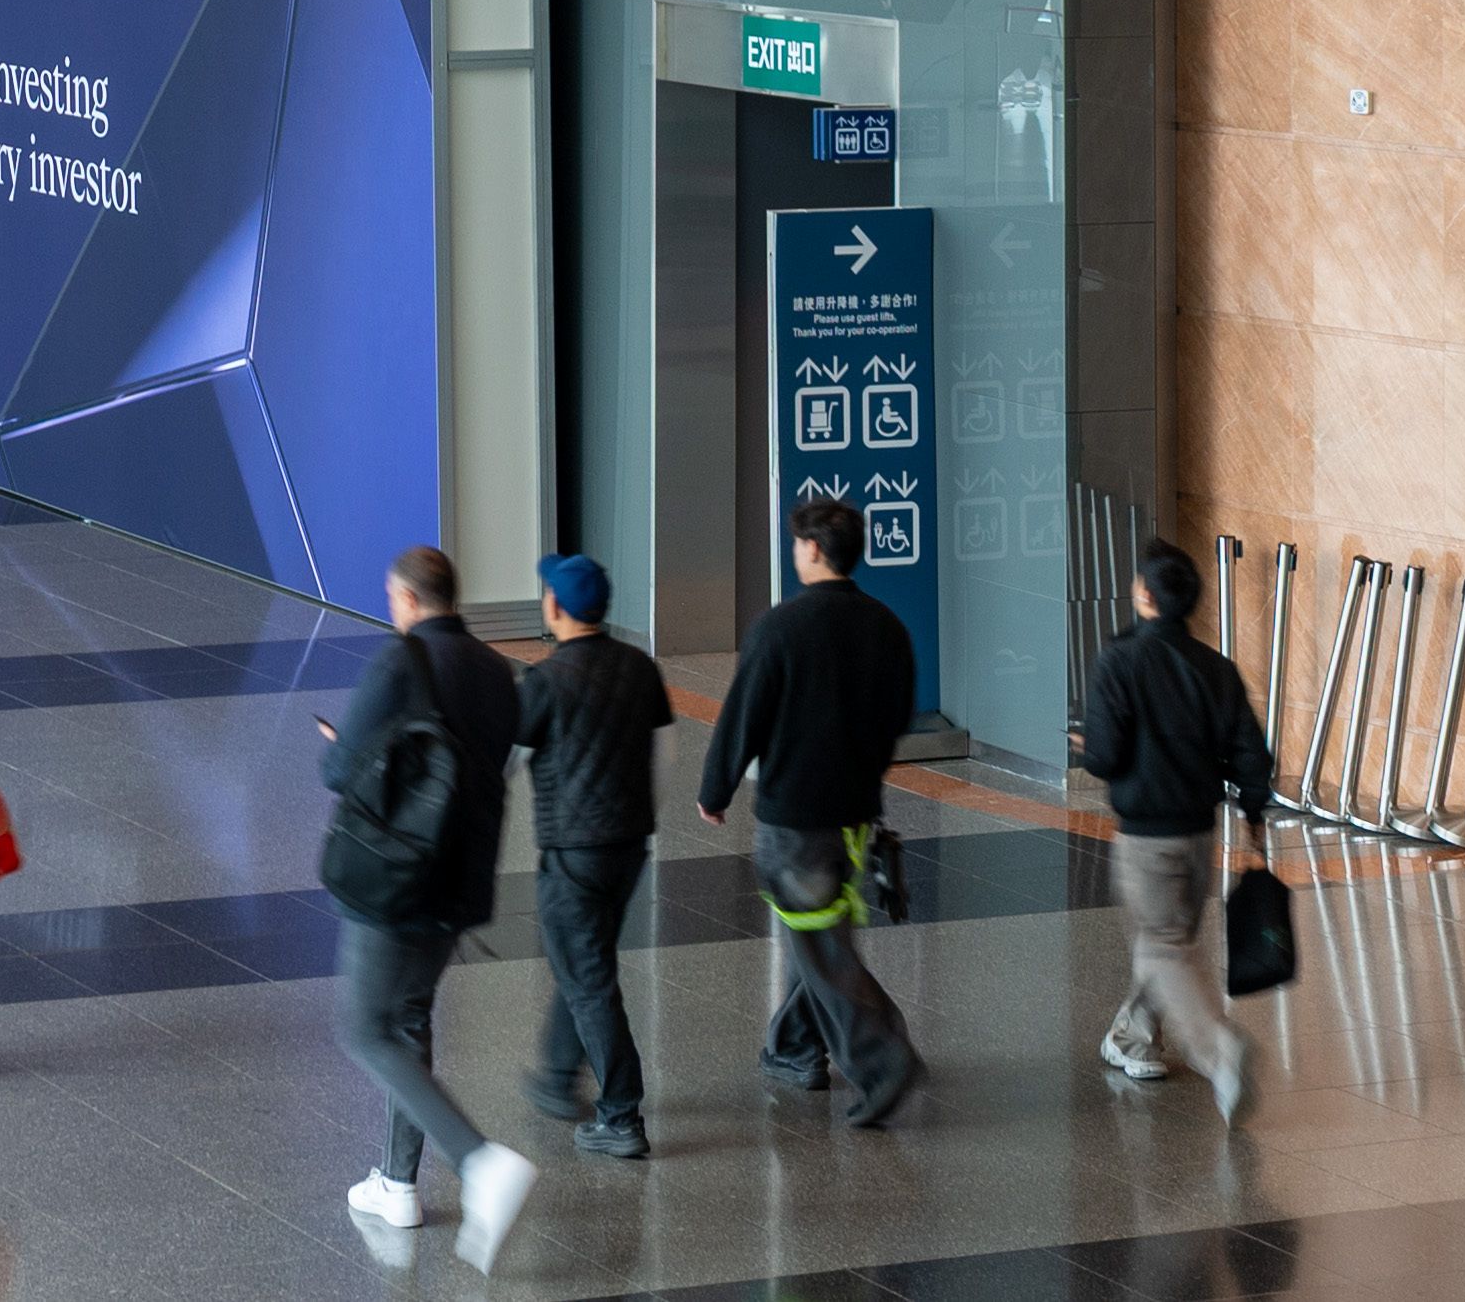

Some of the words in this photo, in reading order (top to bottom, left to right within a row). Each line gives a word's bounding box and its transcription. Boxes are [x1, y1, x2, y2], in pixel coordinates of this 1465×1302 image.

[747, 35, 785, 71] EXIT
[787, 39, 815, 75] 出口
[29, 133, 142, 215] investor
[813, 313, 839, 324] Please
[840, 315, 855, 323] use
[856, 314, 878, 324] guest
[793, 327, 817, 337] Thank
[818, 329, 833, 339] you
[834, 326, 846, 336] for
[847, 327, 865, 338] your
